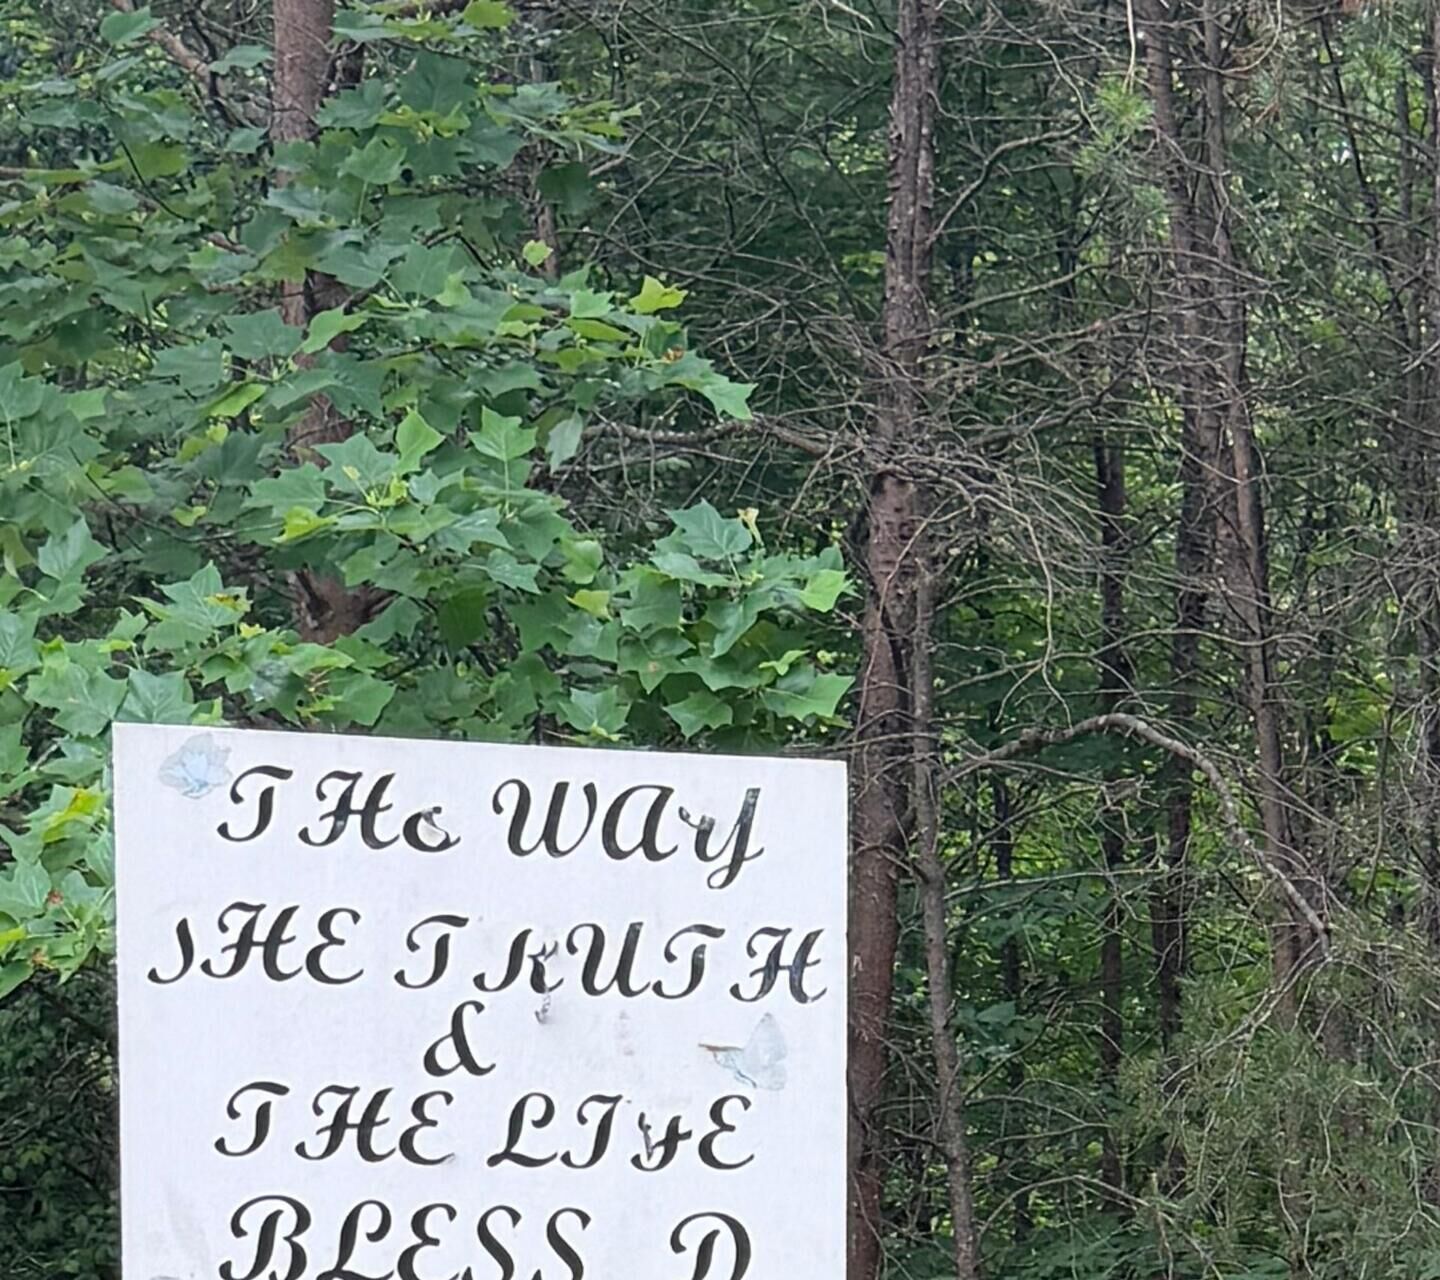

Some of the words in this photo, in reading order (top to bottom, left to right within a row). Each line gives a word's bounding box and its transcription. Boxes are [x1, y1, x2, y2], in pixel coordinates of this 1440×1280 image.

[491, 777, 766, 890] WAY
[423, 1000, 498, 1077] &
[214, 1081, 455, 1166] THE
